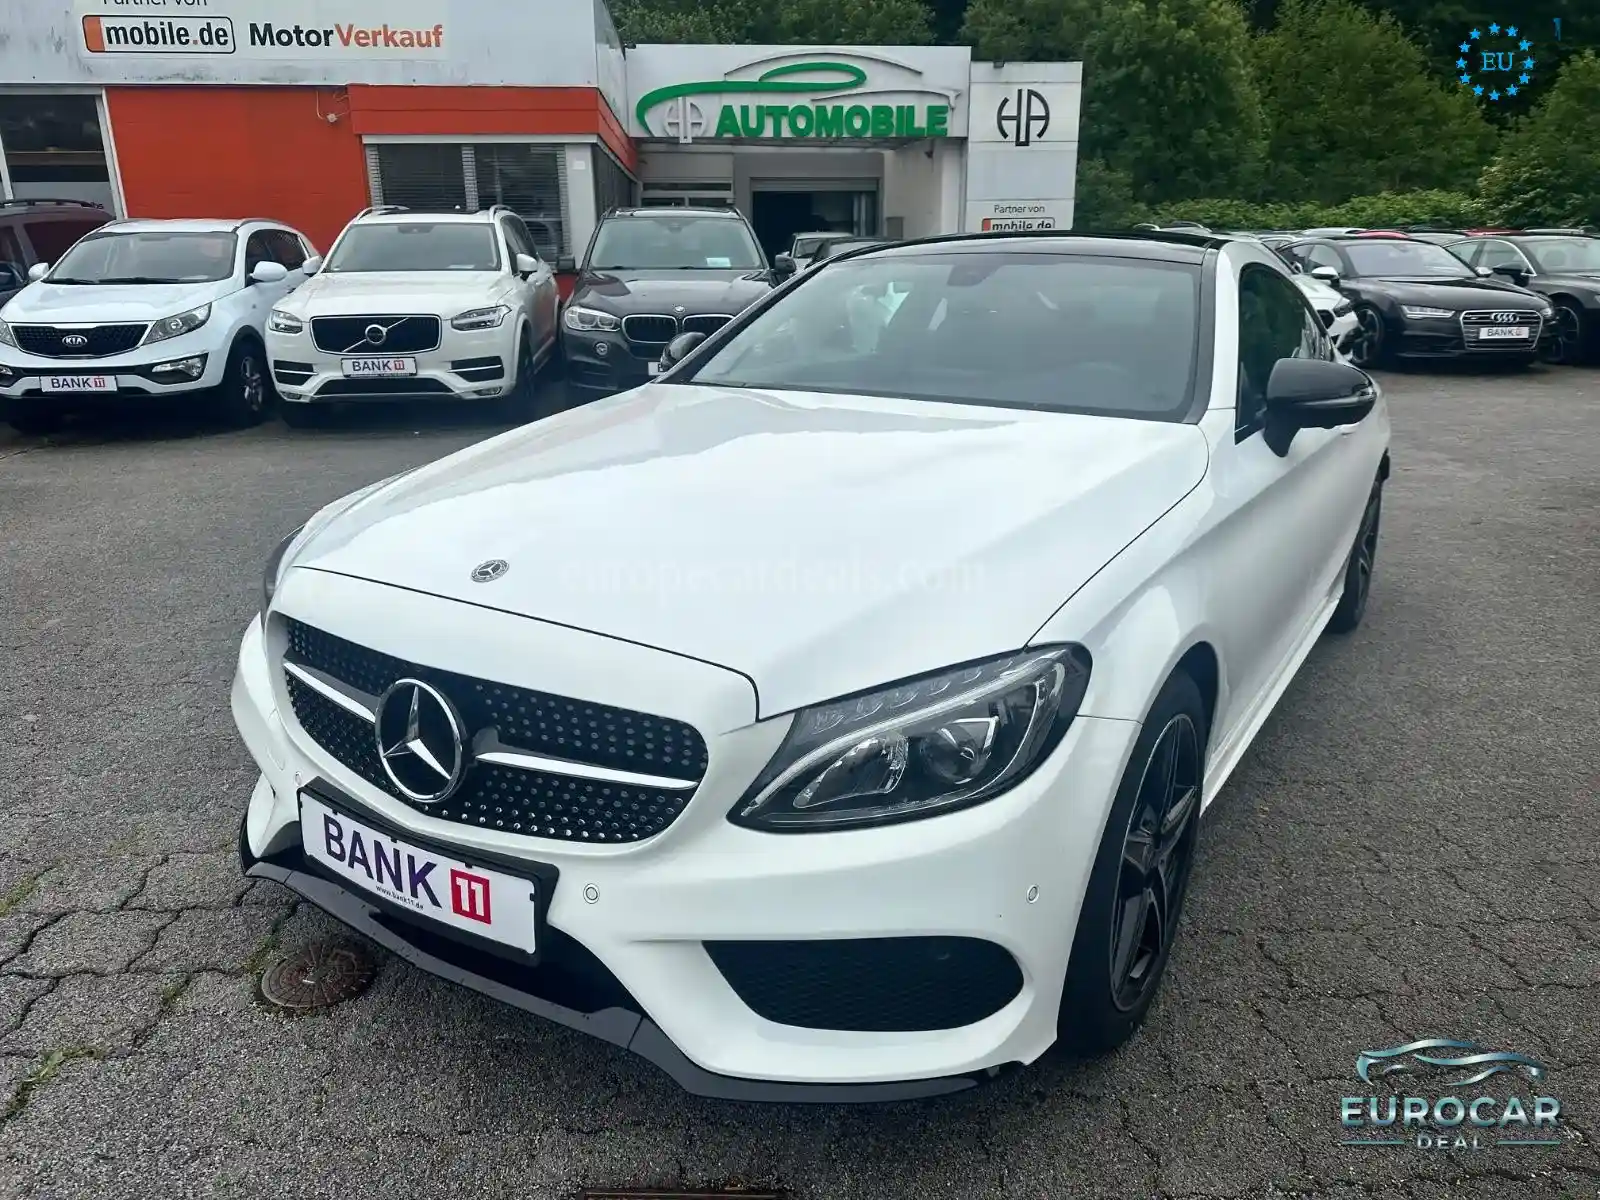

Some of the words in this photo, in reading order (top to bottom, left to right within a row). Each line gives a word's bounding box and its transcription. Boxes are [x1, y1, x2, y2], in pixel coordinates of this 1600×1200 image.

[105, 21, 229, 45] mobile.de
[714, 104, 950, 138] AUTOMOBILE
[994, 204, 1026, 214] Partner
[1028, 205, 1046, 213] von
[992, 220, 1052, 231] mobilede
[65, 337, 83, 345] KIA
[351, 360, 392, 372] BANK
[51, 377, 92, 389] BANK
[323, 813, 442, 910] BANK
[453, 873, 487, 920] 11
